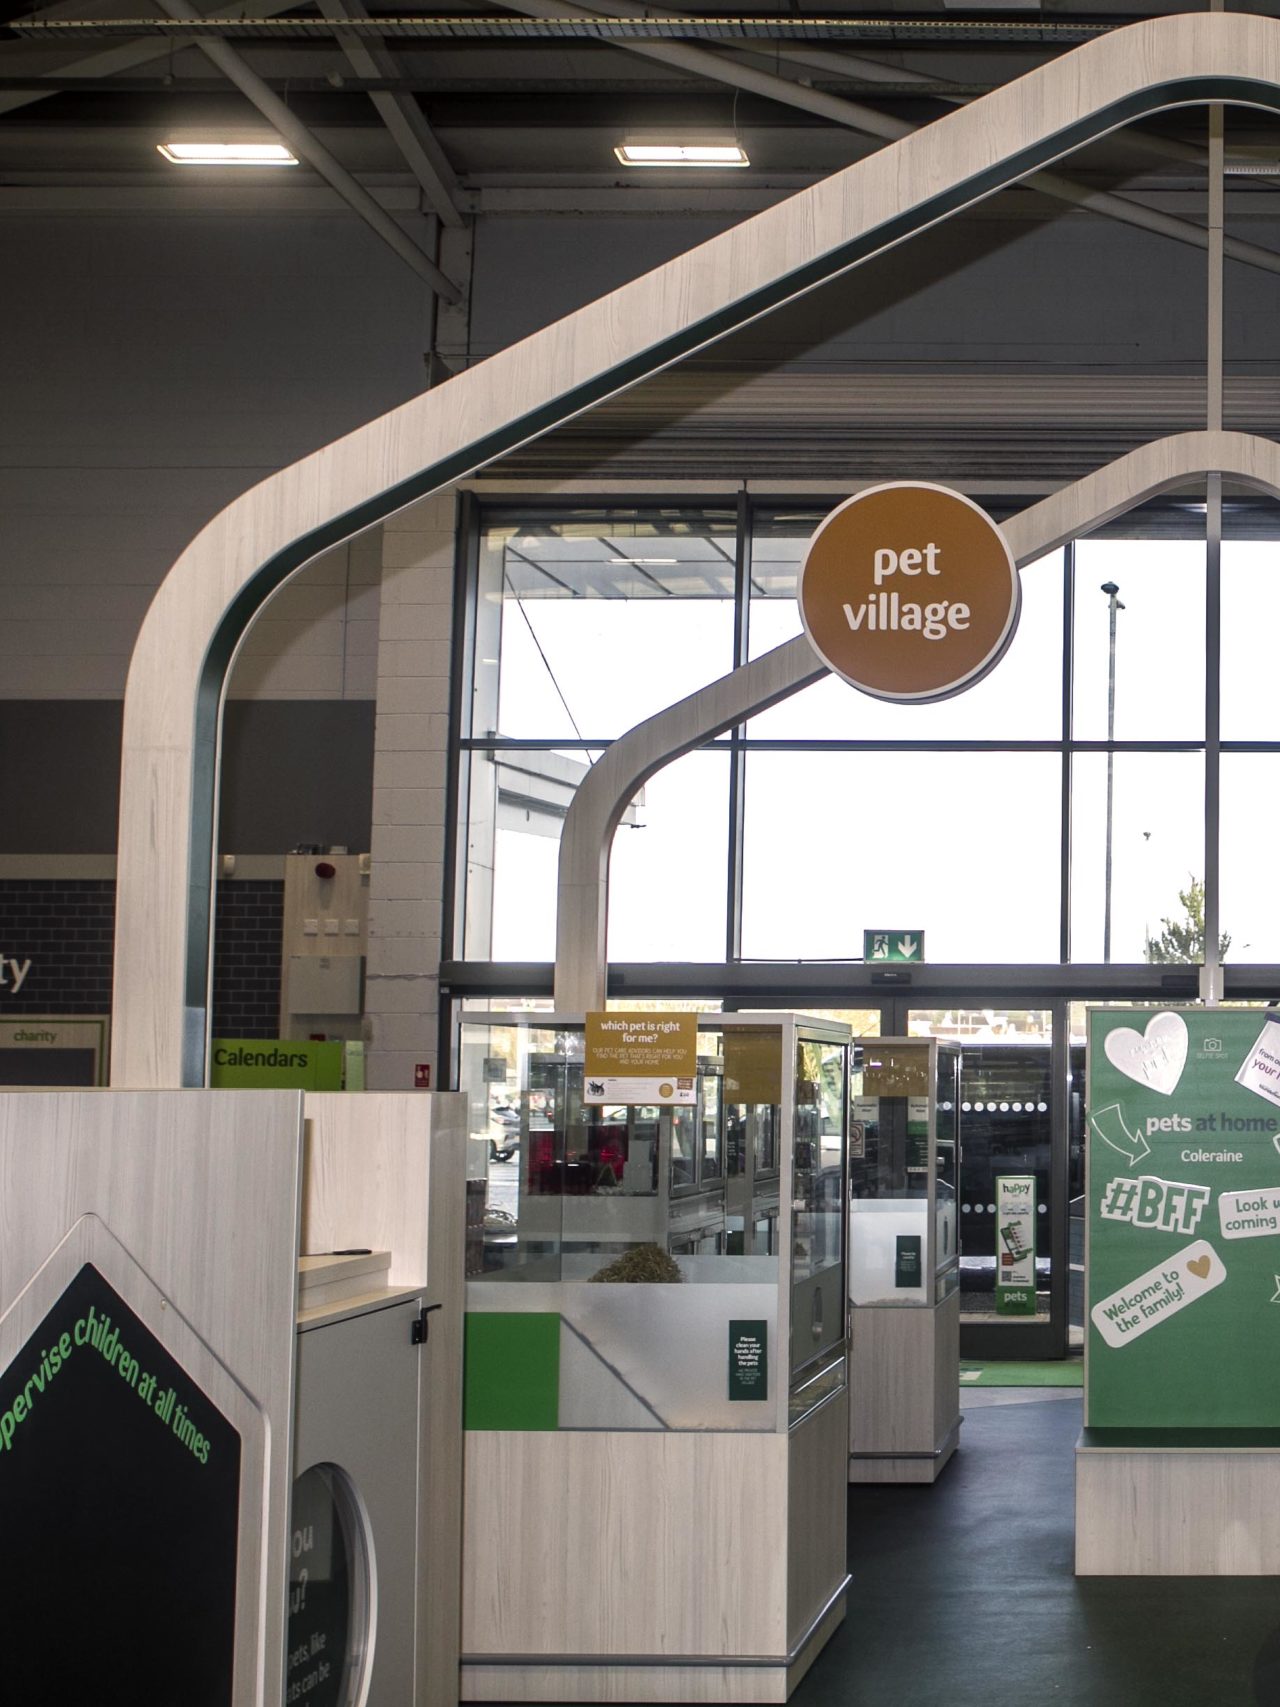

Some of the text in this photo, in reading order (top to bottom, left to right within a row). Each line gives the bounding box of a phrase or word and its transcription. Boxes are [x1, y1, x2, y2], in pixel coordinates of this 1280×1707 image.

[874, 542, 941, 585] pet
[843, 592, 971, 640] village
[14, 1030, 57, 1042] charity
[601, 1021, 680, 1033] which pet is right
[623, 1033, 658, 1043] for me?
[214, 1048, 308, 1067] Calendars
[1258, 1049, 1275, 1062] from
[1252, 1059, 1276, 1077] your
[1146, 1113, 1278, 1135] pets at home
[1181, 1149, 1243, 1162] Coleraine
[1104, 1178, 1208, 1231] #BFF
[1235, 1197, 1268, 1213] Look
[1225, 1213, 1277, 1231] coming
[1004, 1292, 1027, 1302] pets
[1103, 1270, 1179, 1322] Welcome to
[1116, 1284, 1185, 1333] the family!
[0, 1306, 211, 1464] pervise children at all times
[293, 1526, 314, 1558] ou
[310, 1632, 326, 1656] like
[302, 1670, 319, 1694] can
[319, 1661, 331, 1682] be
